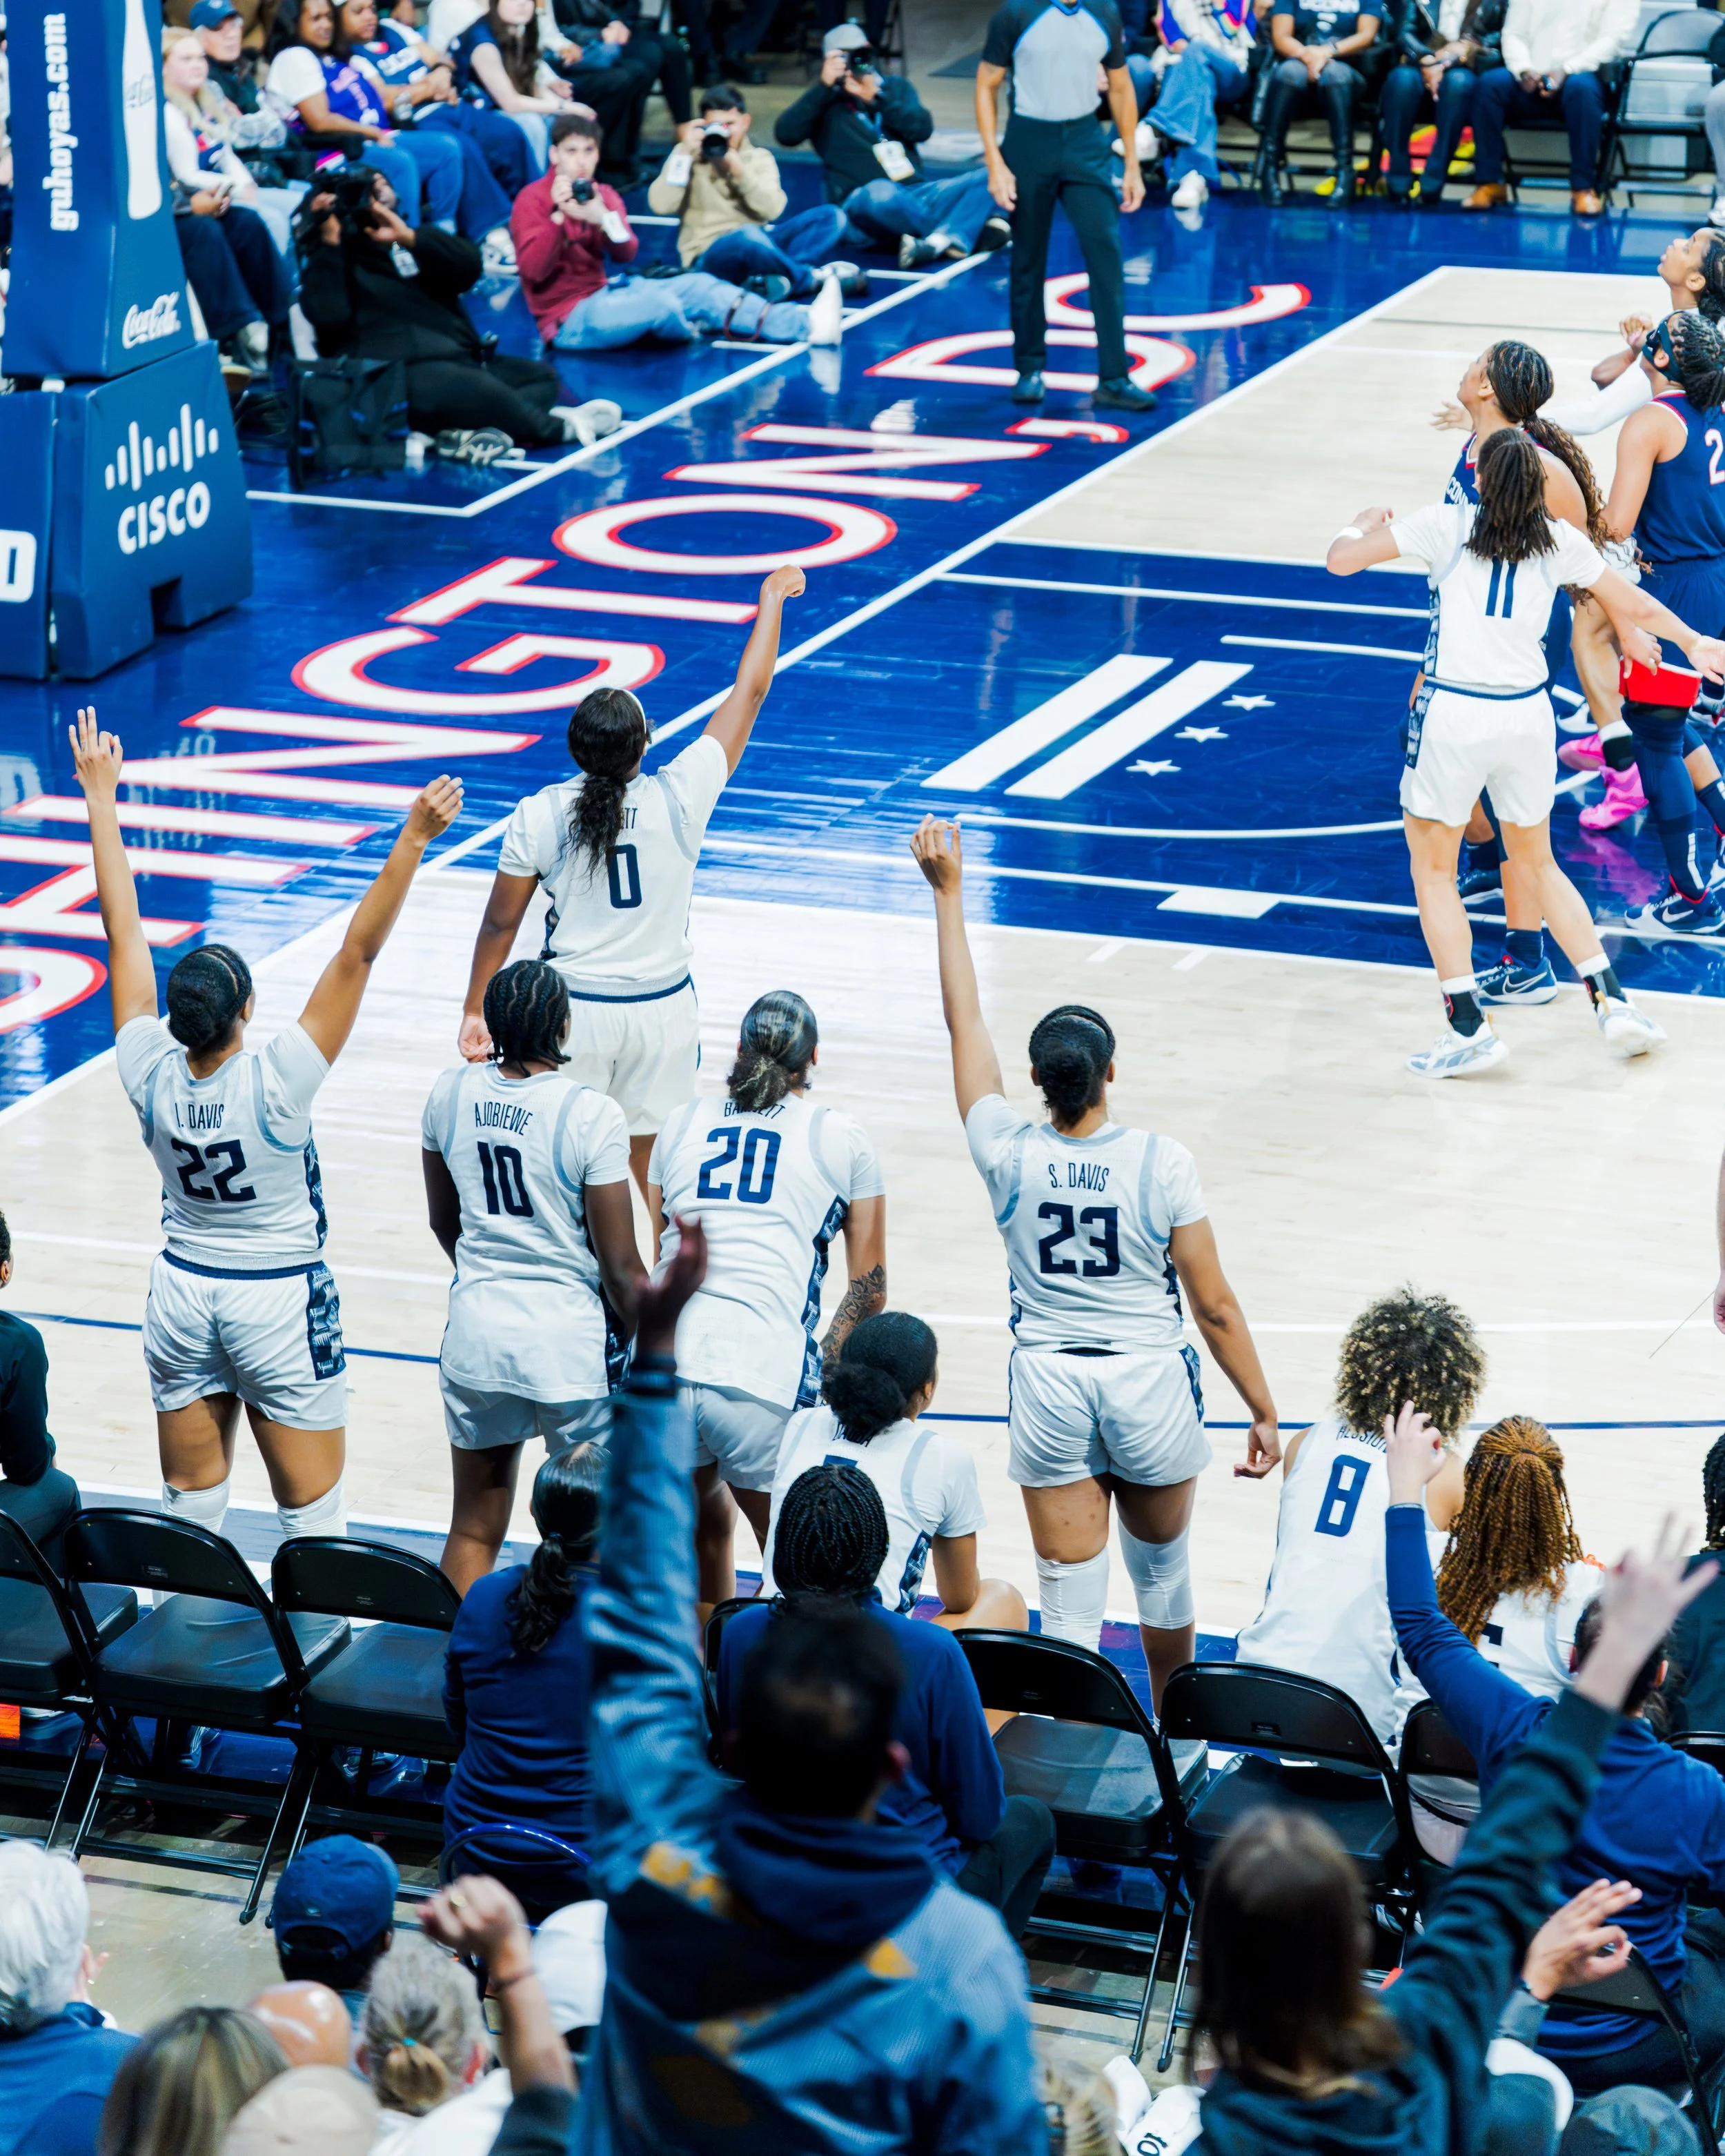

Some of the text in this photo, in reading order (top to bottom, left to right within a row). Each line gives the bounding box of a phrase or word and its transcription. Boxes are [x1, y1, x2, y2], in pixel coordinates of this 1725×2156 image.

[42, 12, 79, 232] guhoyas.com
[117, 481, 211, 555] CISCO
[1485, 554, 1519, 619] 11
[605, 843, 642, 909] 0
[188, 1103, 224, 1129] DAVIS
[475, 1101, 533, 1136] AJOBIEWE
[170, 1137, 257, 1203] 22
[477, 1140, 535, 1218] 10
[696, 1125, 782, 1205] 20
[1048, 1162, 1110, 1192] S. DAVIS
[1038, 1201, 1121, 1278] 23
[1314, 1454, 1372, 1538] 8
